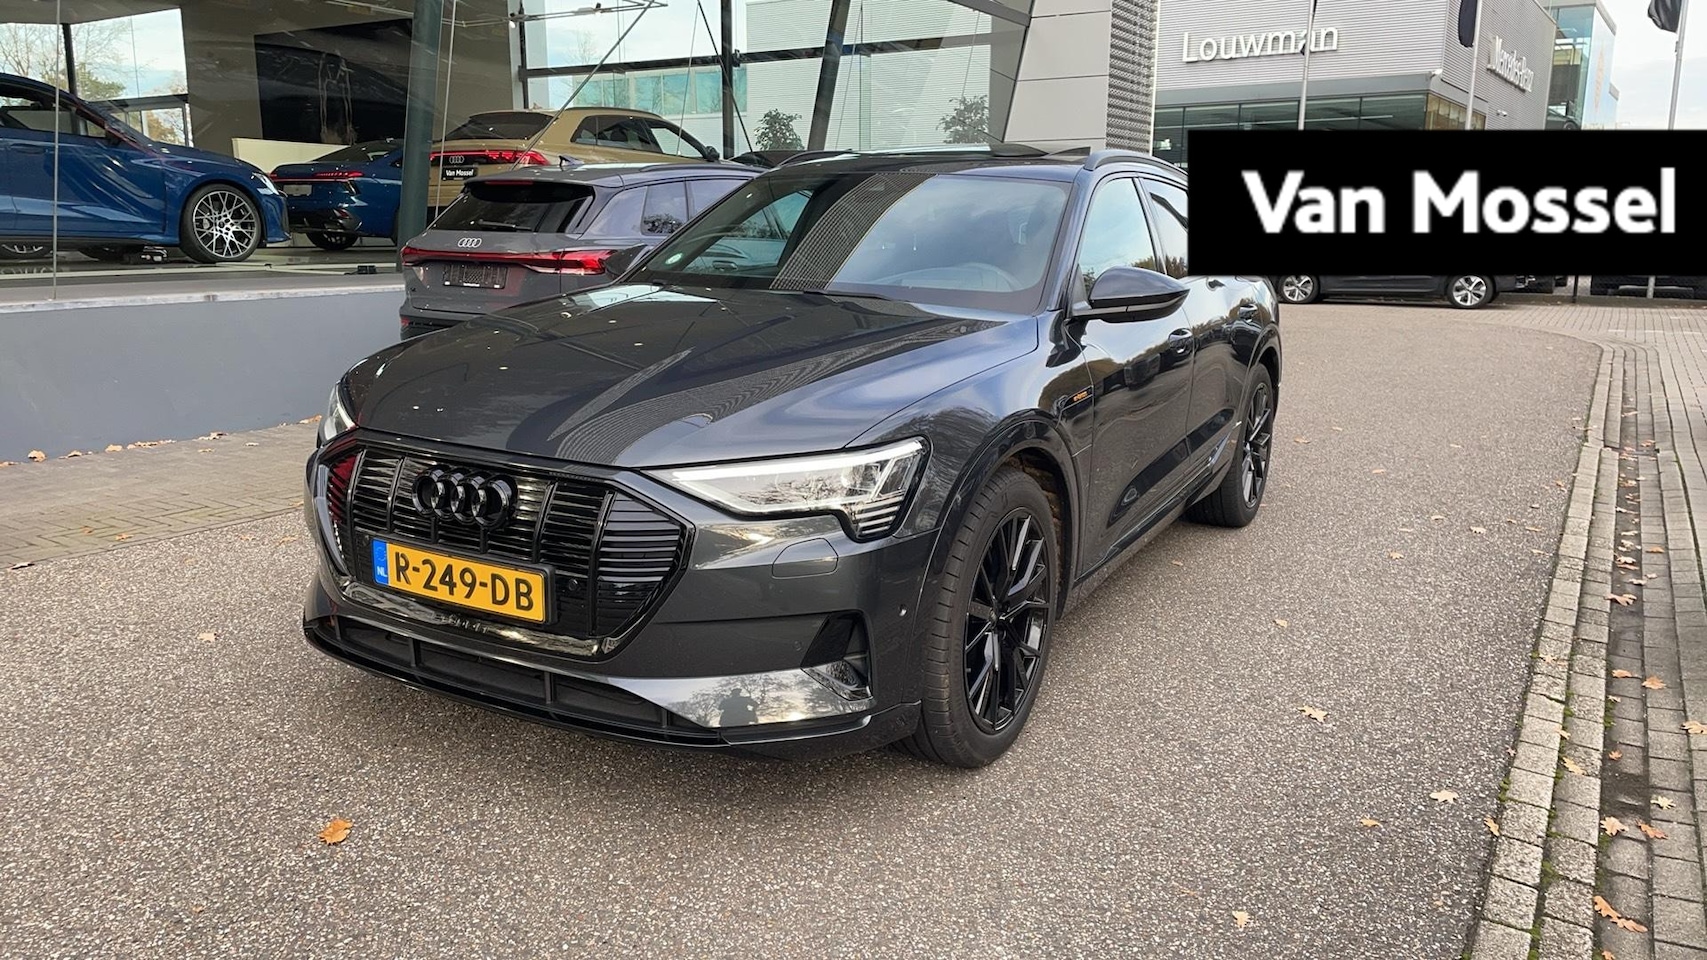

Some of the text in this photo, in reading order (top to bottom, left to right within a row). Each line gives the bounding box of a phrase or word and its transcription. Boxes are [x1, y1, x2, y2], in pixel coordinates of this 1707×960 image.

[1182, 26, 1339, 62] Louwman
[376, 566, 388, 577] NL
[395, 551, 534, 612] R-249-DB
